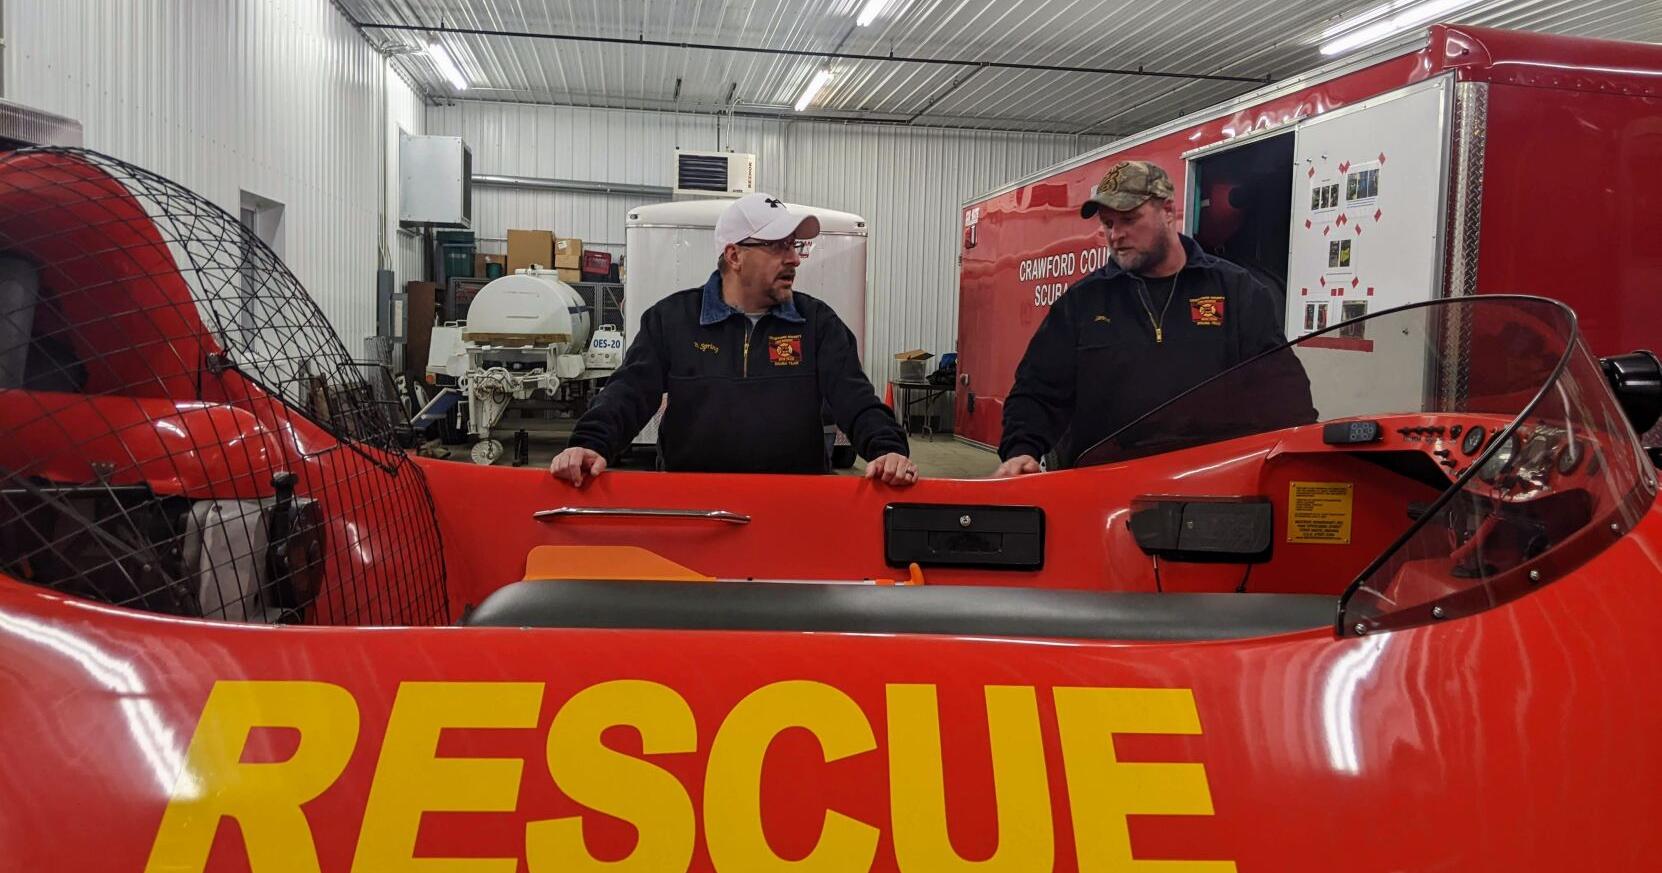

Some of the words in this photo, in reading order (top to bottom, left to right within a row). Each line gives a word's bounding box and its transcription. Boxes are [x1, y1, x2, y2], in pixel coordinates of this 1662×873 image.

[1019, 252, 1076, 281] CRAWFORD
[593, 339, 621, 349] OES-20
[144, 679, 1237, 873] RESCUE
